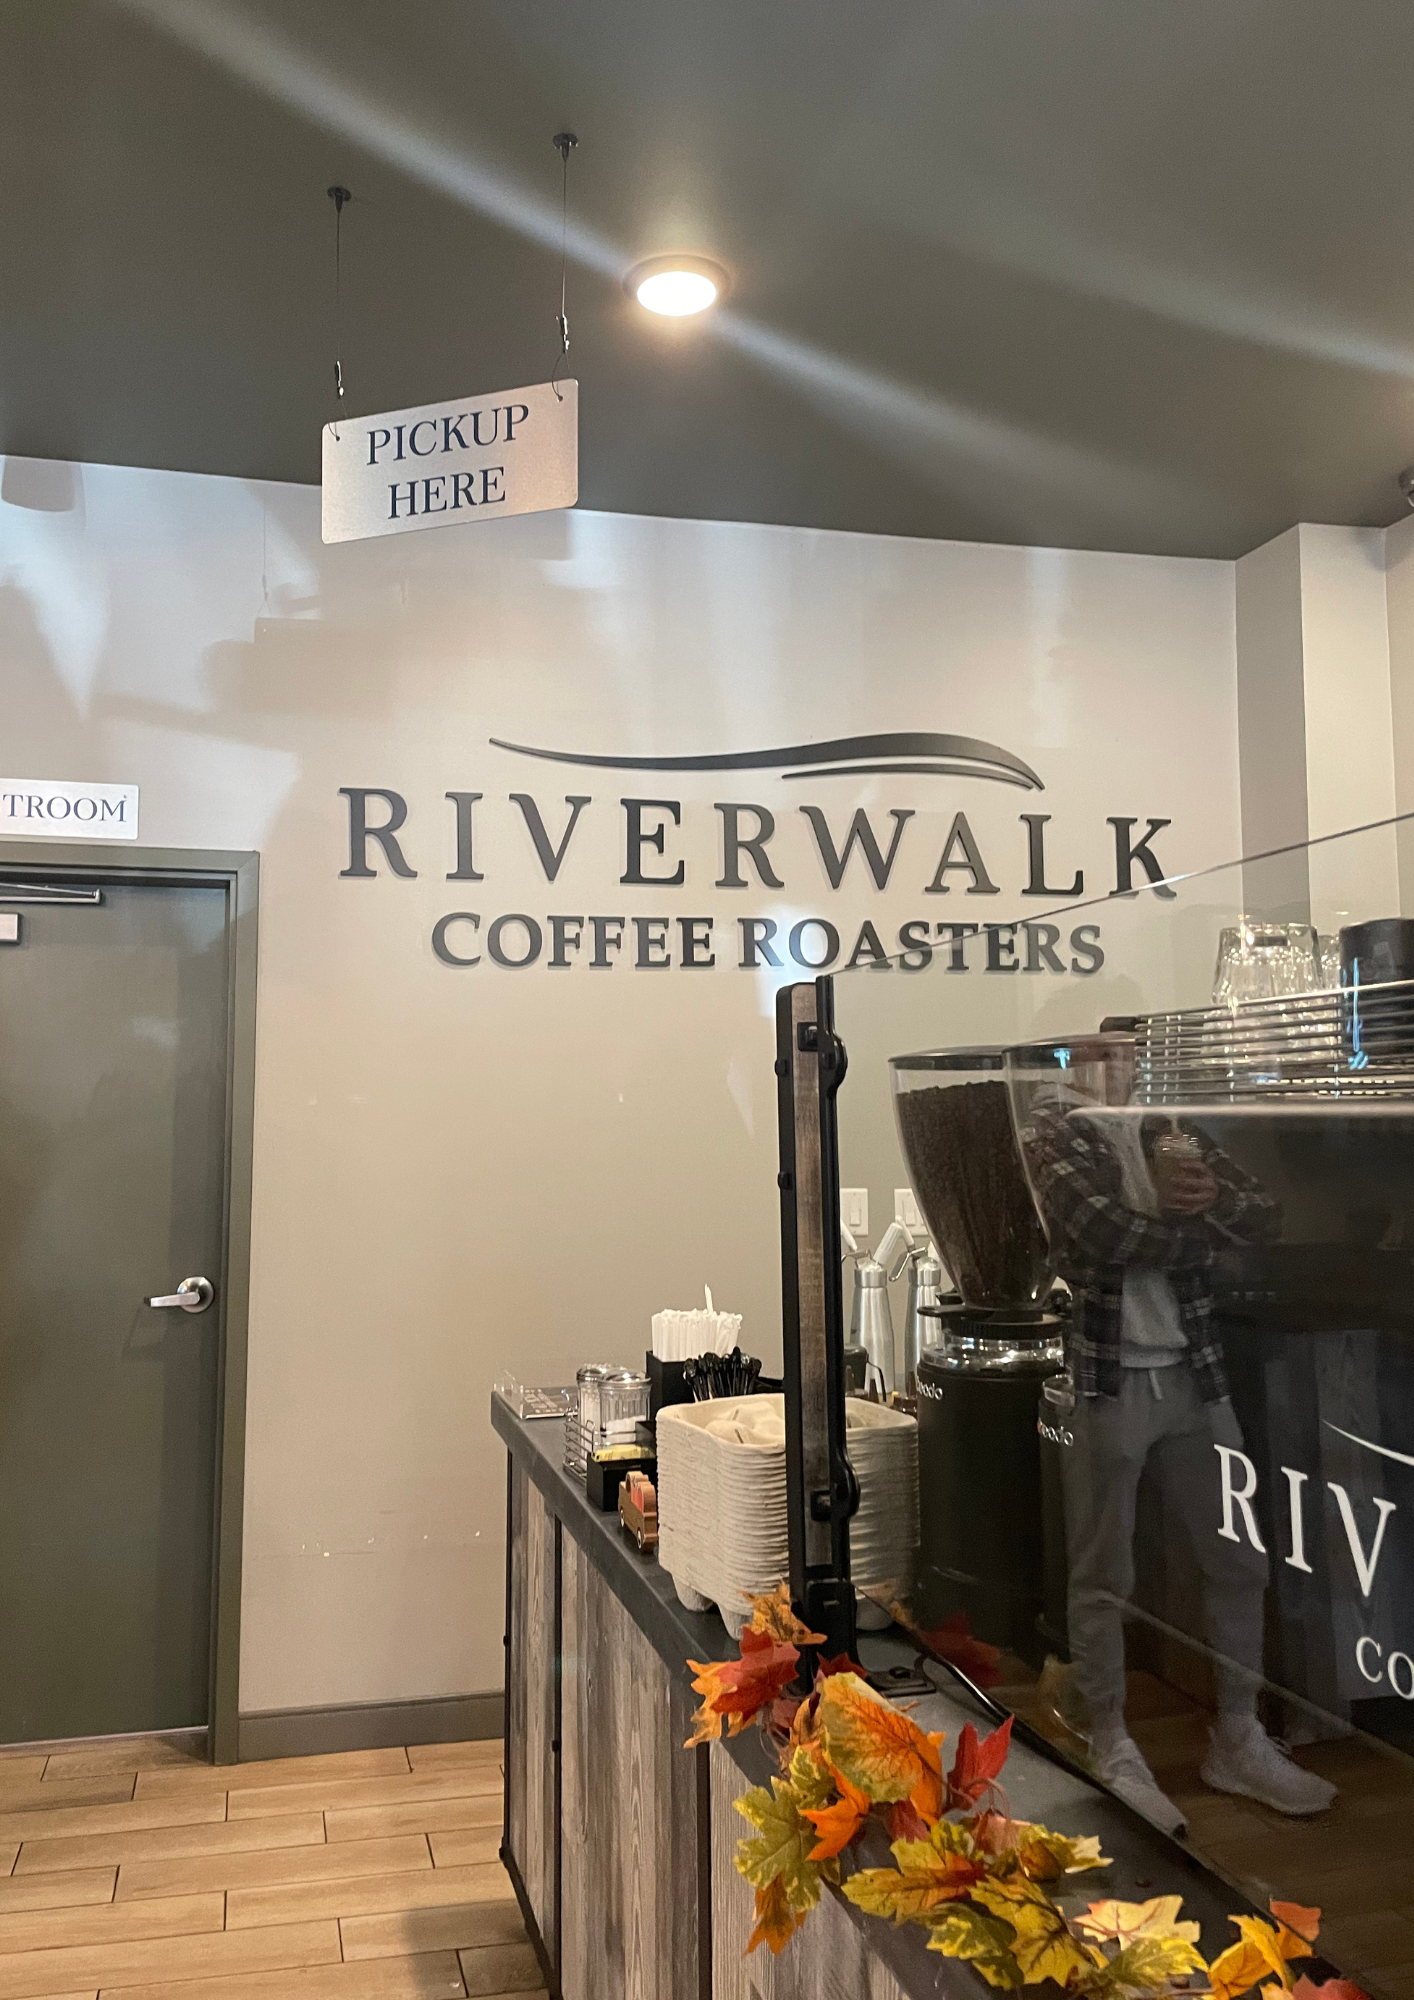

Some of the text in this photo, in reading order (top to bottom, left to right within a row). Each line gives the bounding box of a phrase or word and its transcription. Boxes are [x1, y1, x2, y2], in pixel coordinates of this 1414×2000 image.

[367, 404, 529, 465] PICKUP
[388, 466, 506, 519] HERE
[2, 794, 127, 823] TROOM
[338, 787, 1177, 898] RIVERWALK
[432, 911, 1105, 974] COFFEE ROASTERS
[1213, 1443, 1397, 1598] RIV
[1356, 1636, 1414, 1700] CO
